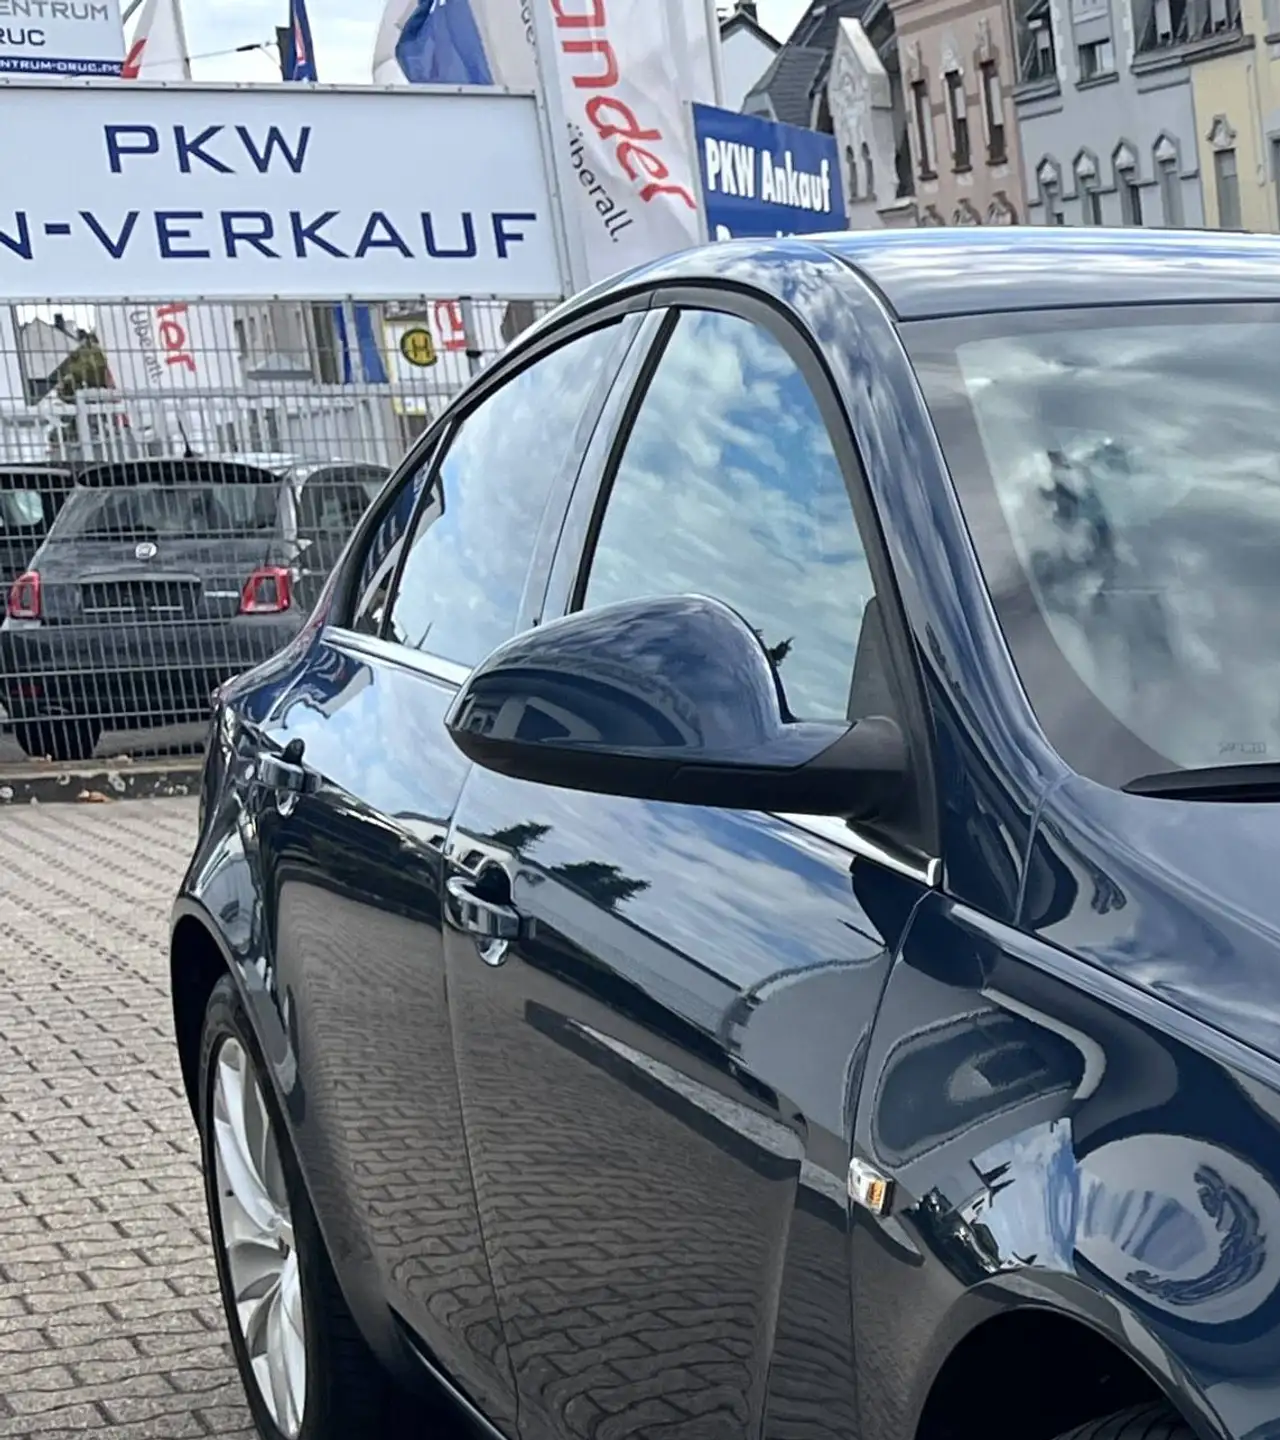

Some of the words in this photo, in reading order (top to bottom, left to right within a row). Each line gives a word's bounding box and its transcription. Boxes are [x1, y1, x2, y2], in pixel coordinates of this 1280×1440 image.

[104, 125, 312, 173] PKW
[704, 137, 755, 198] PKW
[761, 149, 831, 213] Ankauf
